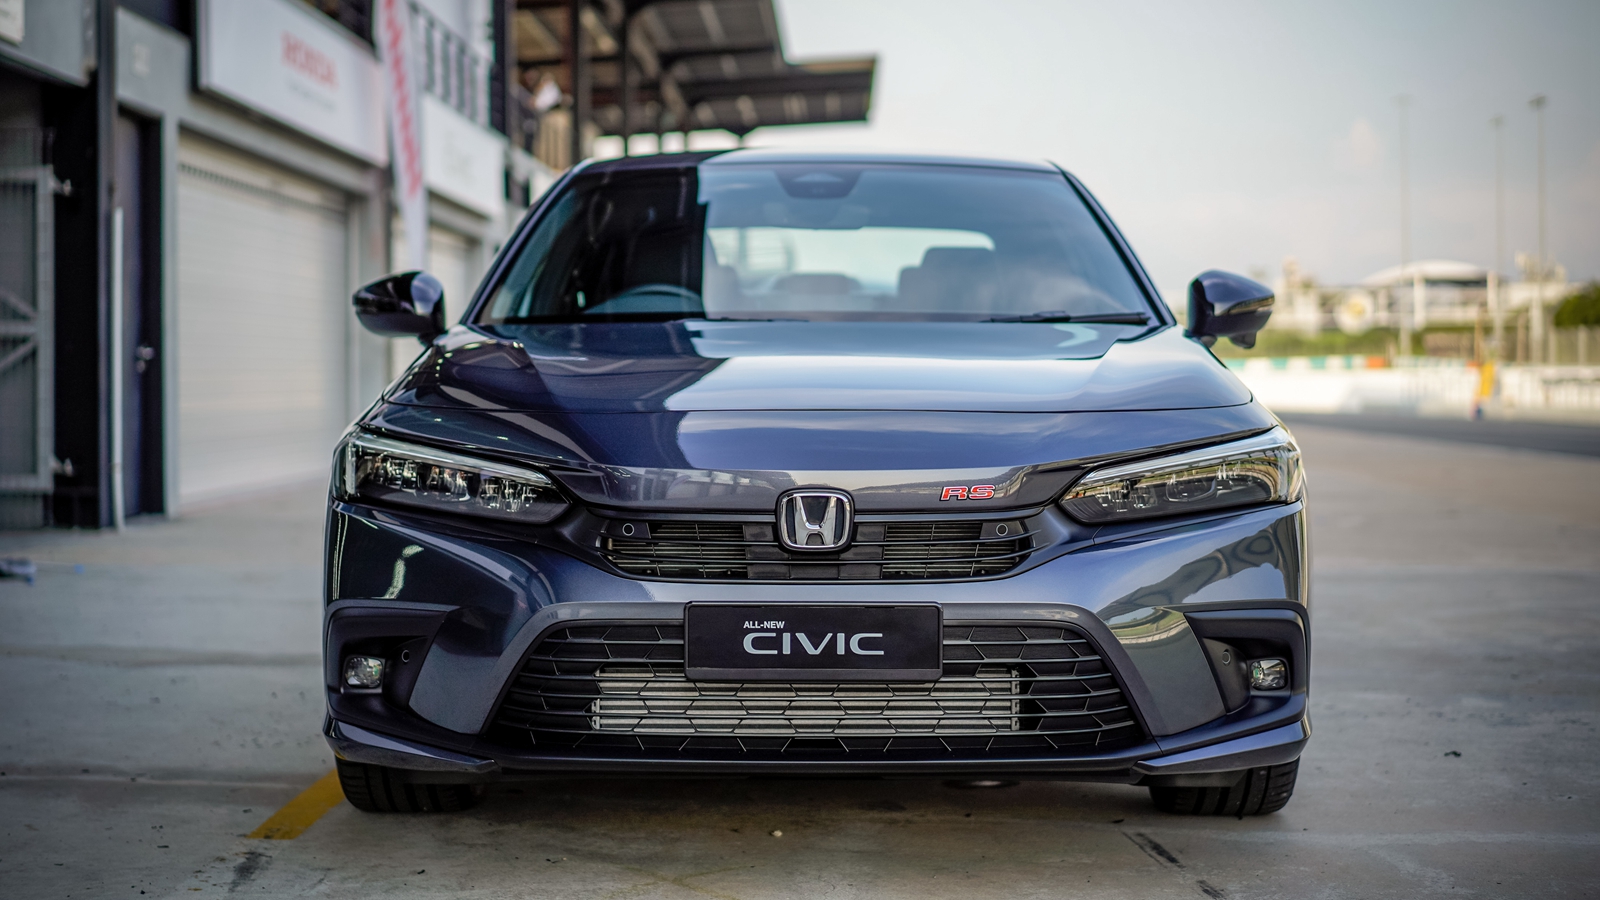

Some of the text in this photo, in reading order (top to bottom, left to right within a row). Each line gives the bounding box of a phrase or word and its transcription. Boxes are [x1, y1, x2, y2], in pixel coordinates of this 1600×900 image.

[940, 485, 995, 500] RS
[743, 620, 785, 629] ALL-NEW
[743, 632, 884, 655] CIVIC
